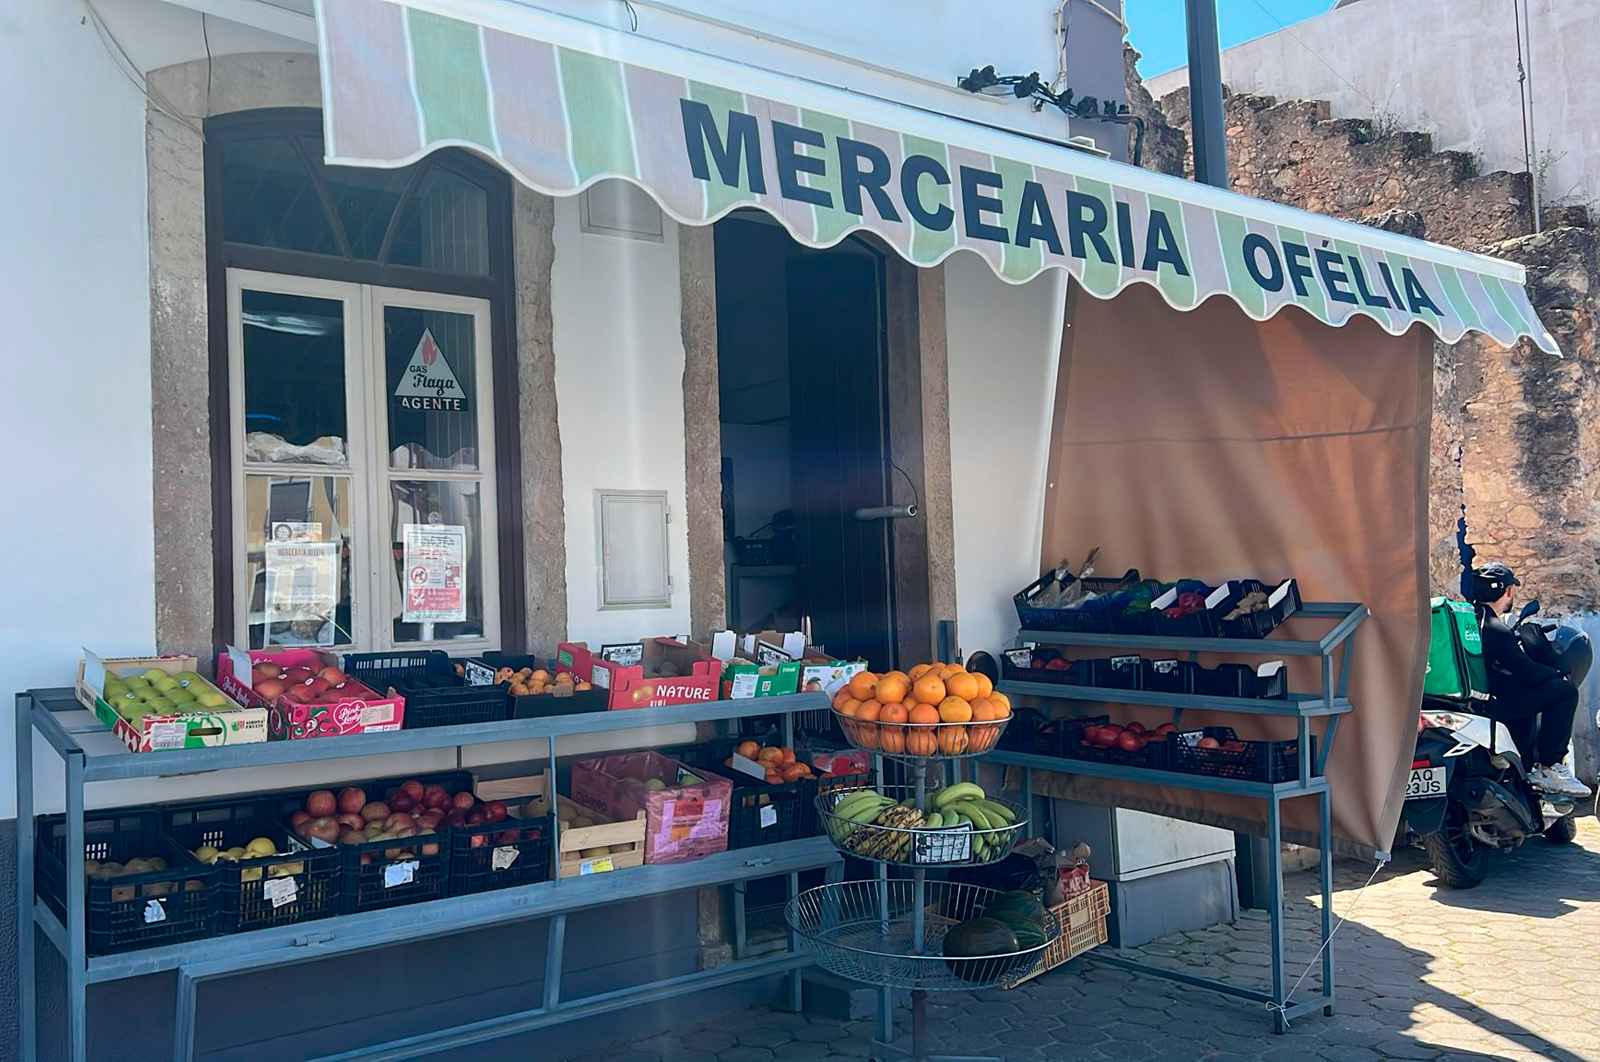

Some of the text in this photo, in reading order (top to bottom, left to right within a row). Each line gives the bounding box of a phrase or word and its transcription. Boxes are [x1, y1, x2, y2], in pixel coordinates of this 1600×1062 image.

[679, 97, 1445, 316] MERCEARIA OFÉLIA
[413, 374, 455, 396] Flaga
[401, 397, 461, 411] AGENTE
[656, 685, 711, 699] NATURE
[339, 704, 360, 719] Pink
[341, 711, 362, 725] Lady
[1411, 769, 1434, 782] AQ
